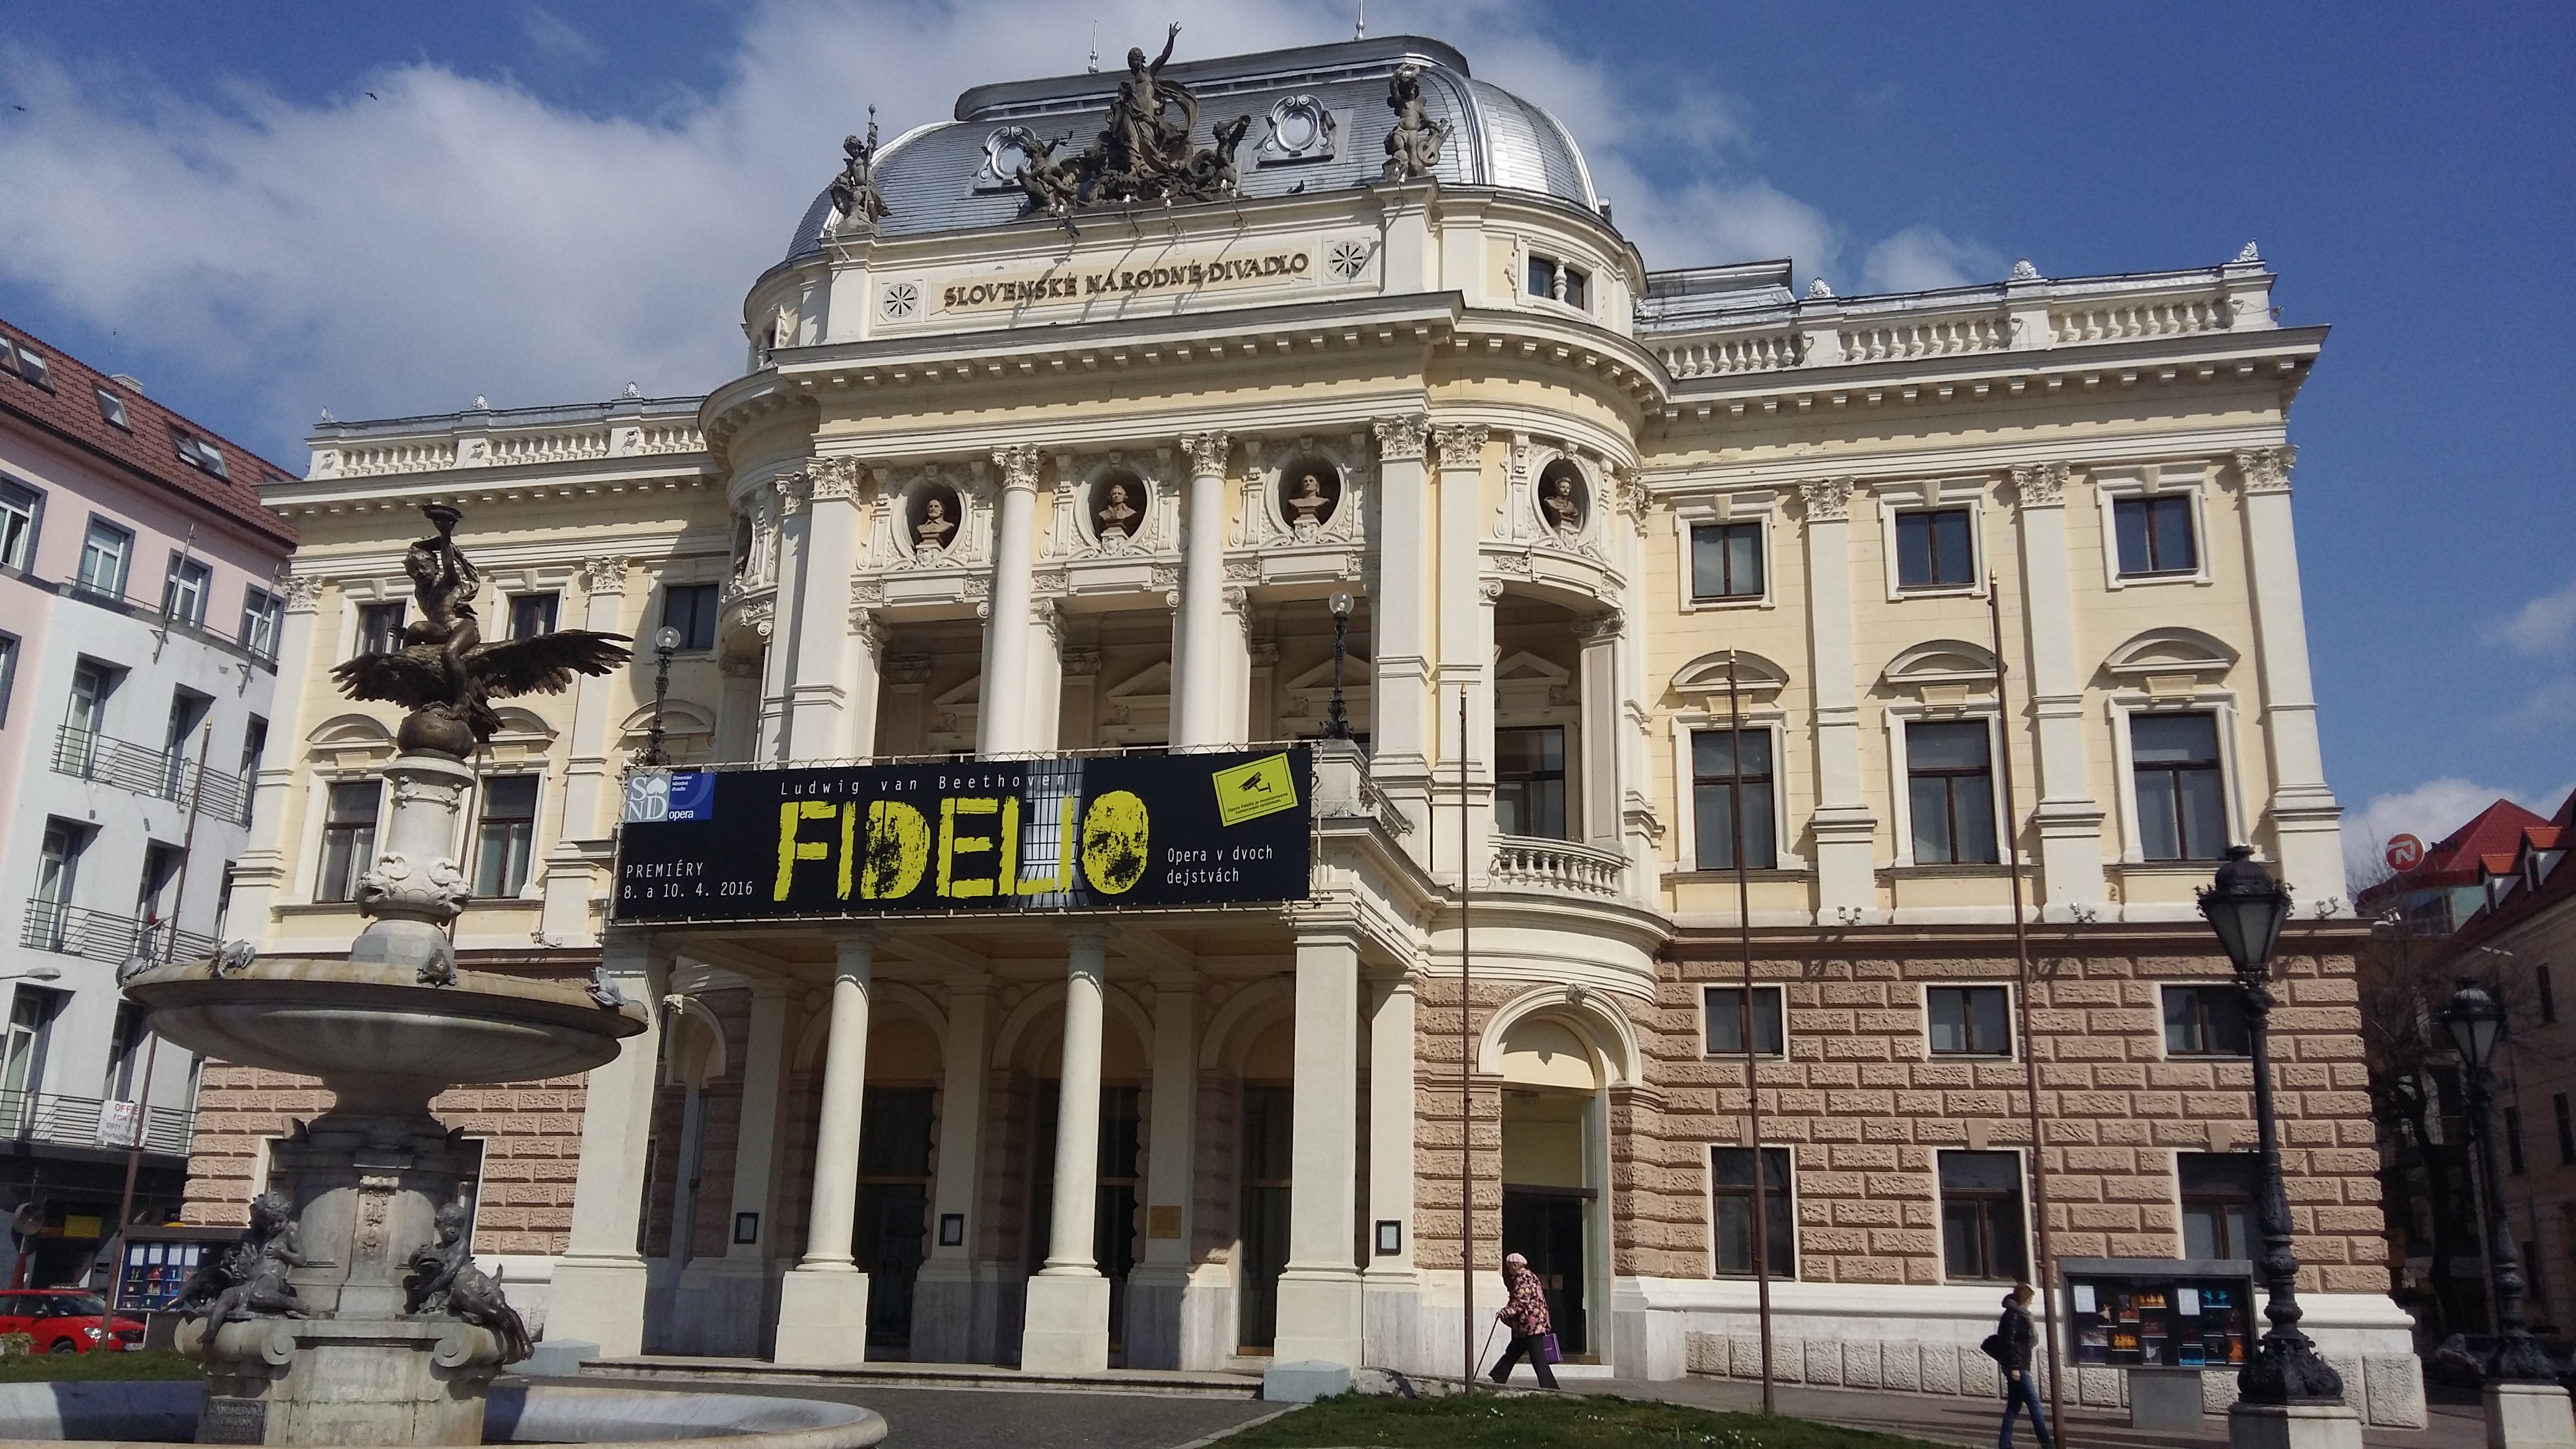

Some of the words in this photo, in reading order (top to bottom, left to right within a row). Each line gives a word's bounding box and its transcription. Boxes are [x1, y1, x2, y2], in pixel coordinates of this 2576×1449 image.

[944, 273, 1077, 307] SLOVENSKÉ
[1085, 259, 1202, 295] NÁRODNÉ
[1209, 253, 1309, 283] DIVADLO
[781, 779, 859, 794] Ludwig
[881, 779, 917, 791] van
[939, 774, 1065, 789] Beethoven
[668, 810, 694, 821] opera
[774, 790, 1149, 902] FIDELIO
[1168, 847, 1206, 866] Opera
[1216, 849, 1223, 861] v
[1232, 844, 1272, 861] dvoch
[626, 859, 703, 879] PREMIÉRY
[1167, 867, 1239, 886] dejstvách
[624, 885, 637, 899] 8.
[646, 887, 653, 898] a
[663, 883, 684, 897] 10.
[695, 882, 709, 896] 4.
[720, 881, 753, 895] 2016
[114, 1113, 127, 1121] FOR
